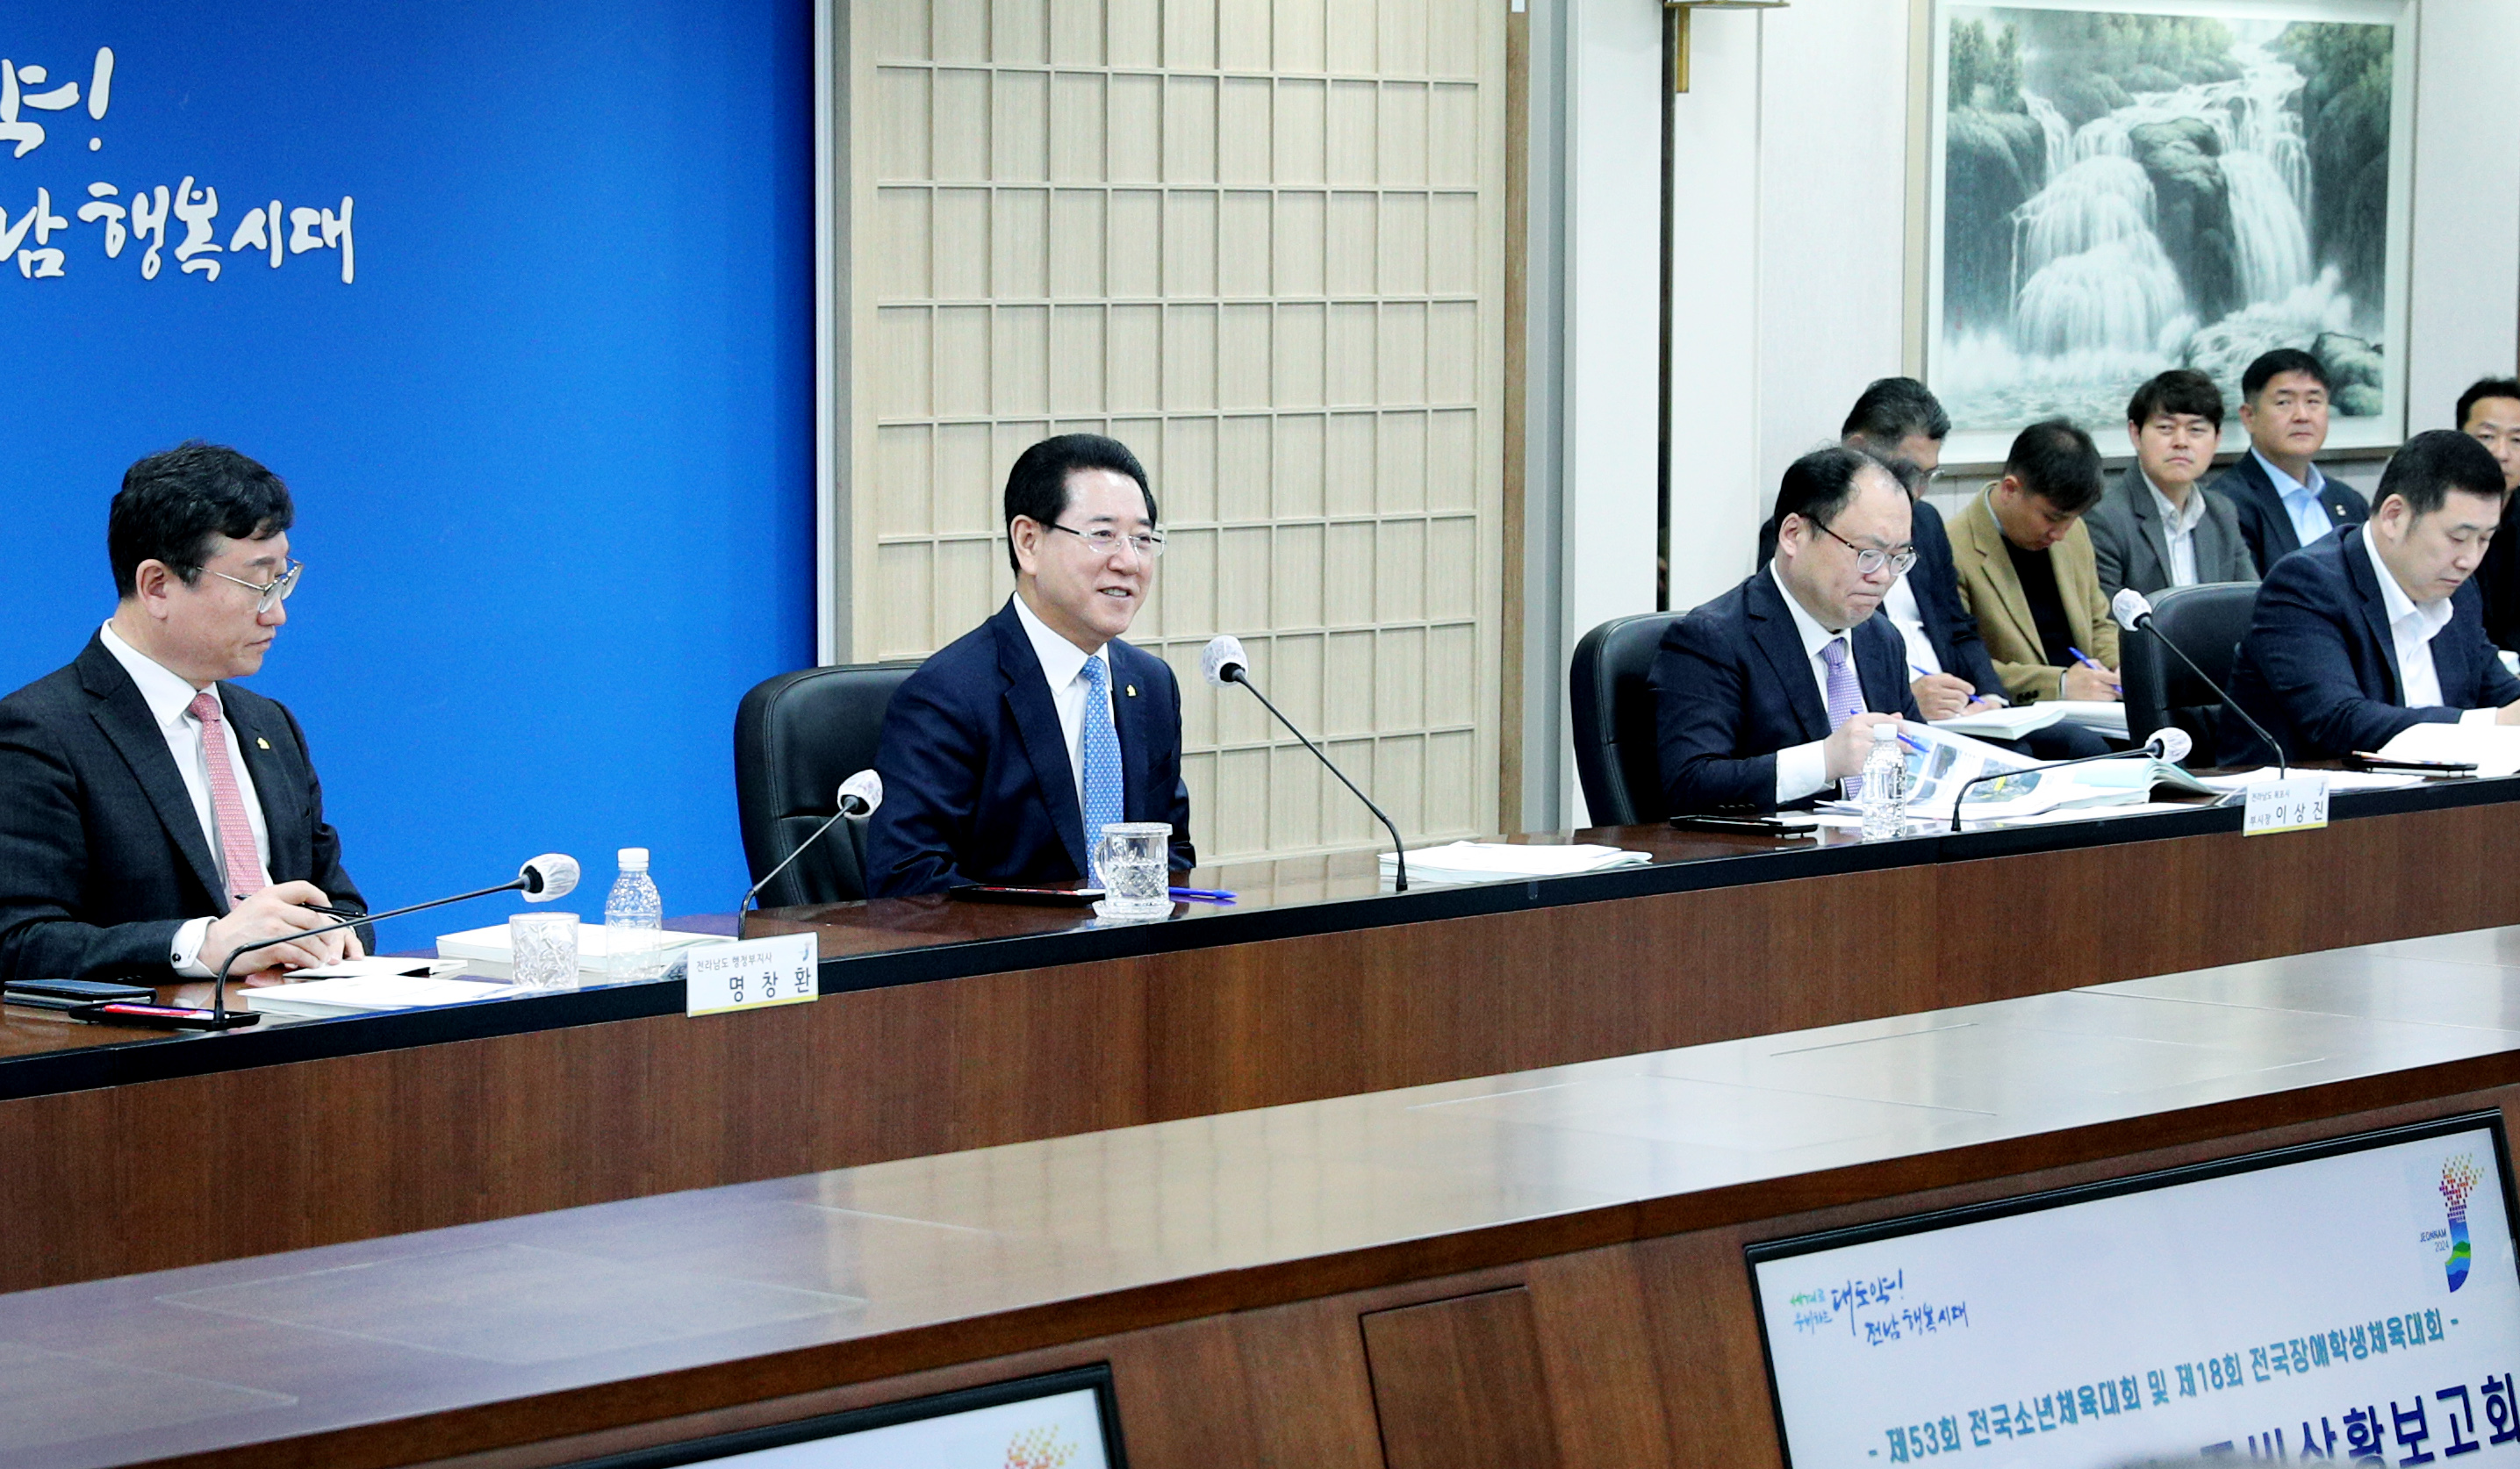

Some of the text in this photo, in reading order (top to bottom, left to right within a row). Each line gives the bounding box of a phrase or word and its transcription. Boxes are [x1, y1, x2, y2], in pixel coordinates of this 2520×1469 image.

[2251, 792, 2272, 803] 전라남도
[2250, 813, 2272, 826] 부시장
[696, 959, 729, 973] 전라남도
[732, 952, 773, 970] 행정부지사
[2420, 1228, 2447, 1243] JEONNAM
[2435, 1240, 2450, 1252] 2024
[1831, 1268, 1904, 1336] 대도약!
[1864, 1314, 1902, 1346] 전남
[1885, 1414, 1962, 1464] 제53회
[1967, 1374, 2142, 1448] 전국소년체육대회
[2147, 1368, 2170, 1406] 및
[2175, 1352, 2244, 1398] 제18회
[2249, 1308, 2445, 1382] 전국장애학생체육대회
